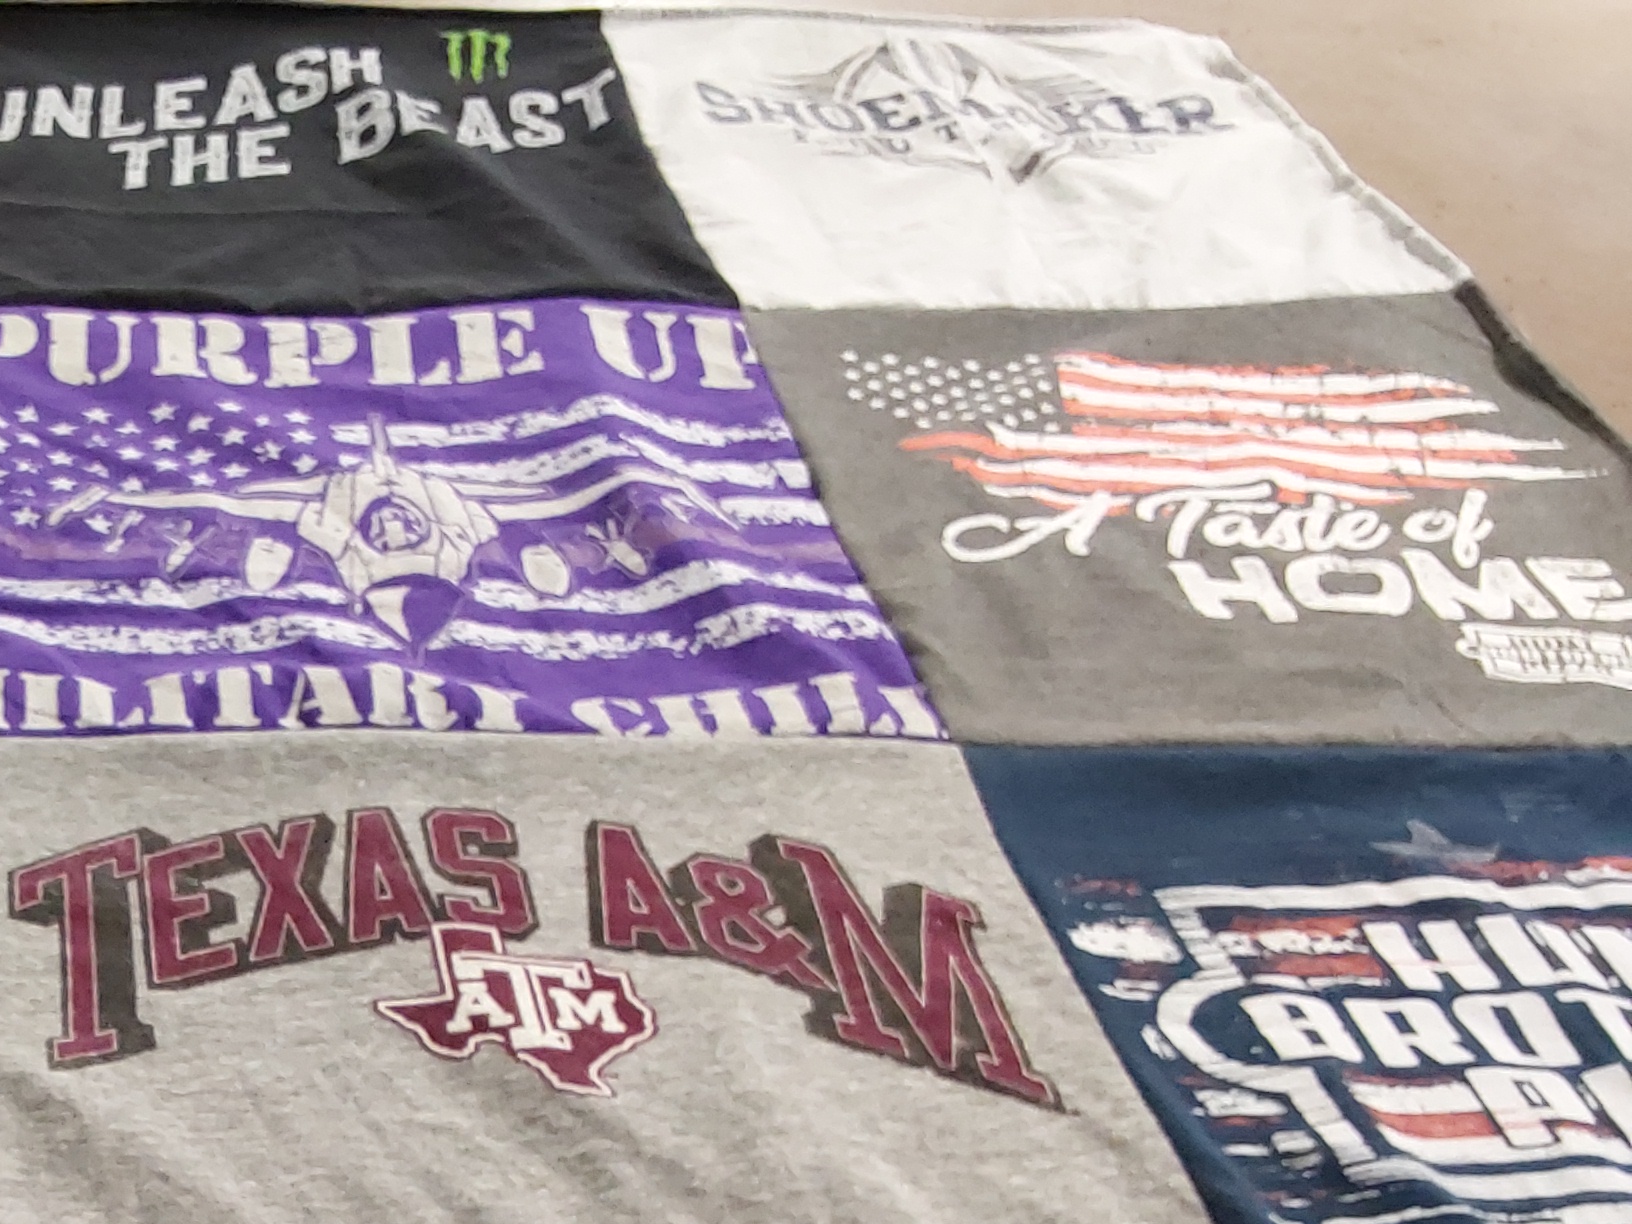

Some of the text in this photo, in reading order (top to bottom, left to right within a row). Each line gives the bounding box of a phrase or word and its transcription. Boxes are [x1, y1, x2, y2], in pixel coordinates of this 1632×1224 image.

[108, 68, 616, 191] THE BEAST
[941, 482, 1495, 570] A Taste of
[1168, 548, 1632, 623] HOME
[571, 671, 950, 740] CHIL
[7, 804, 1068, 1114] TEXAS A&M
